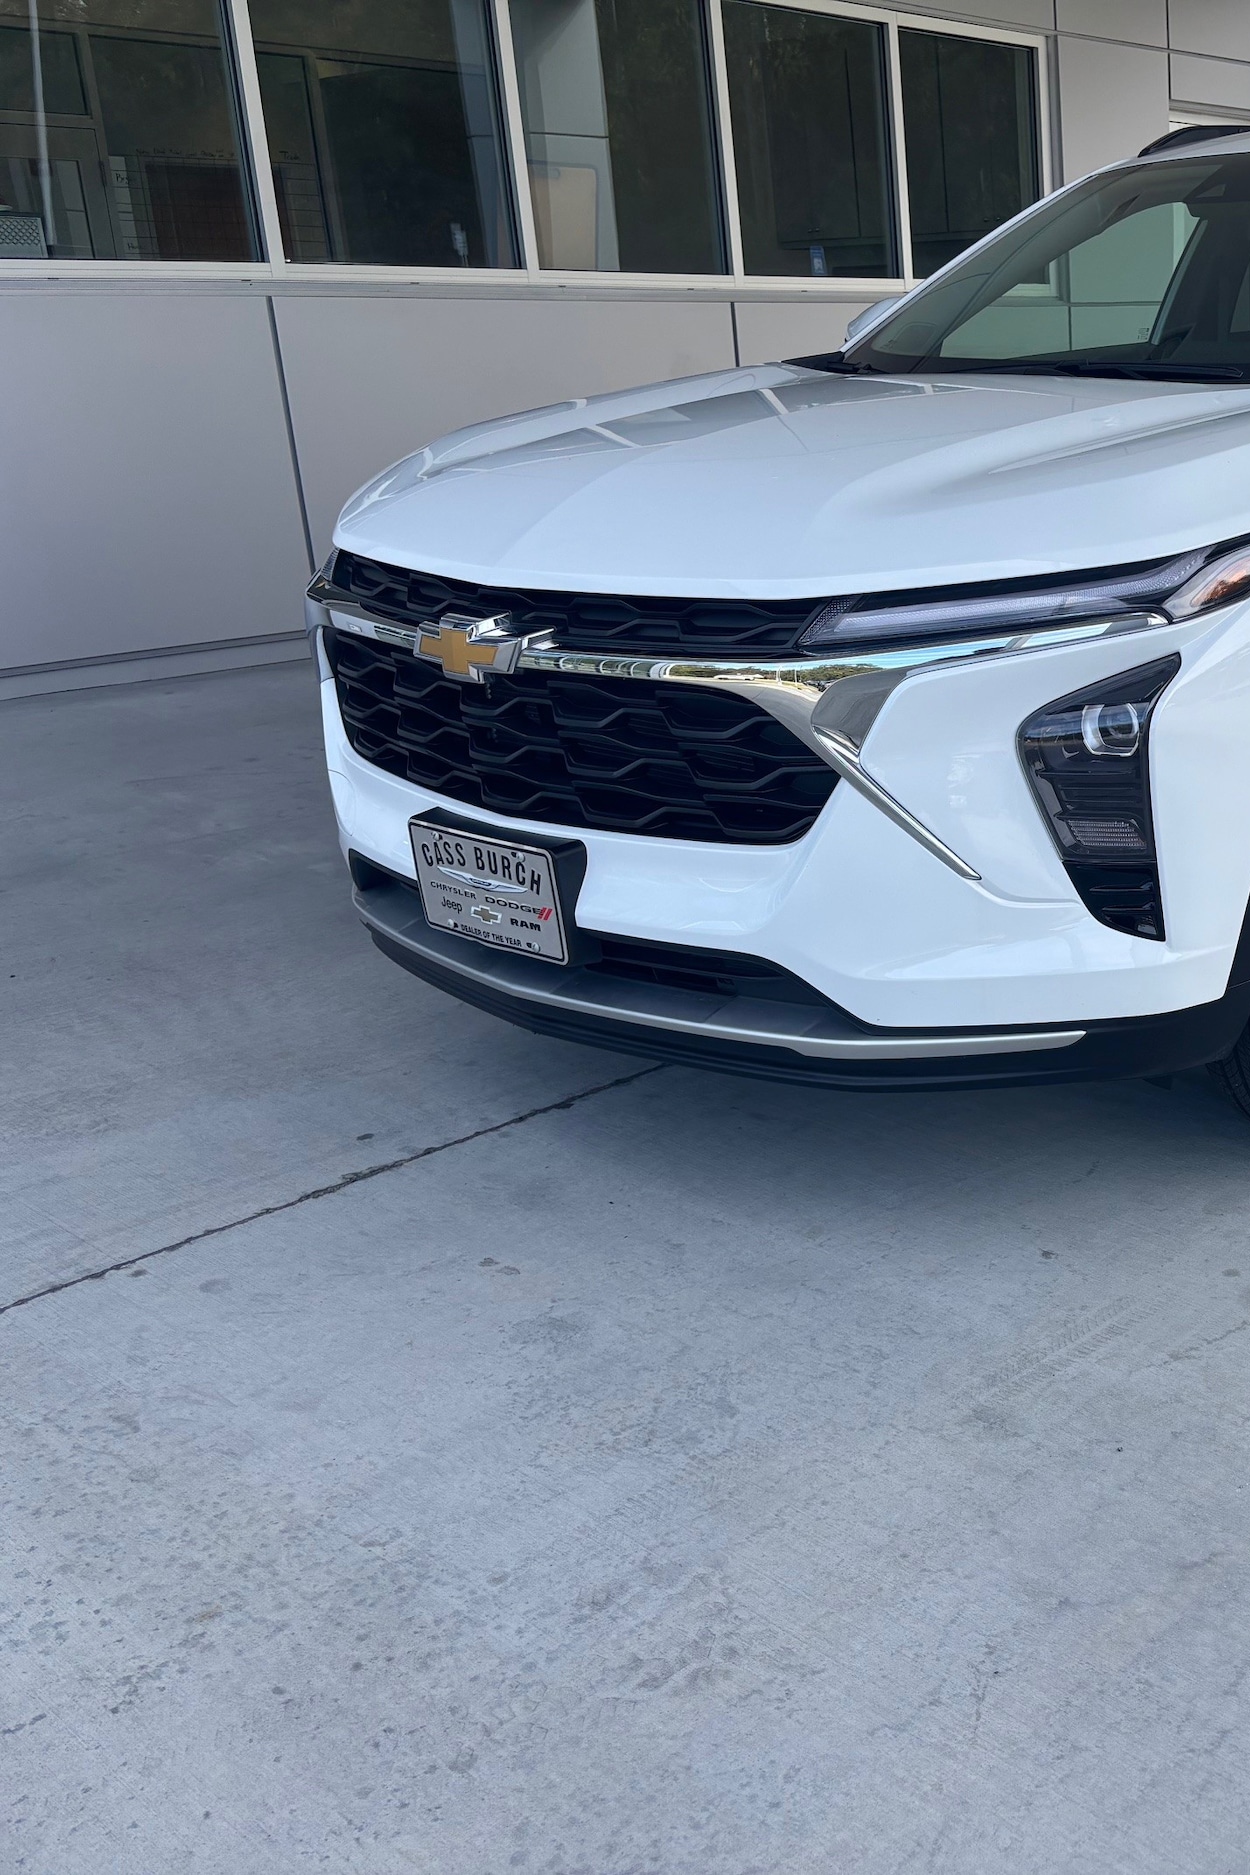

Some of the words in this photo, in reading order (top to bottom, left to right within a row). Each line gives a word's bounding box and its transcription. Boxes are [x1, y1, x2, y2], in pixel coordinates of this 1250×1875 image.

[421, 841, 466, 867] CASS
[474, 846, 542, 896] BURCH
[430, 881, 477, 900] CHRYSLER
[485, 896, 543, 915] DODGE
[441, 896, 463, 914] Jeep
[510, 917, 542, 932] RAM
[460, 923, 482, 936] DEALER
[482, 930, 491, 939] OF
[491, 933, 505, 943] THE
[504, 936, 522, 947] YEAR
